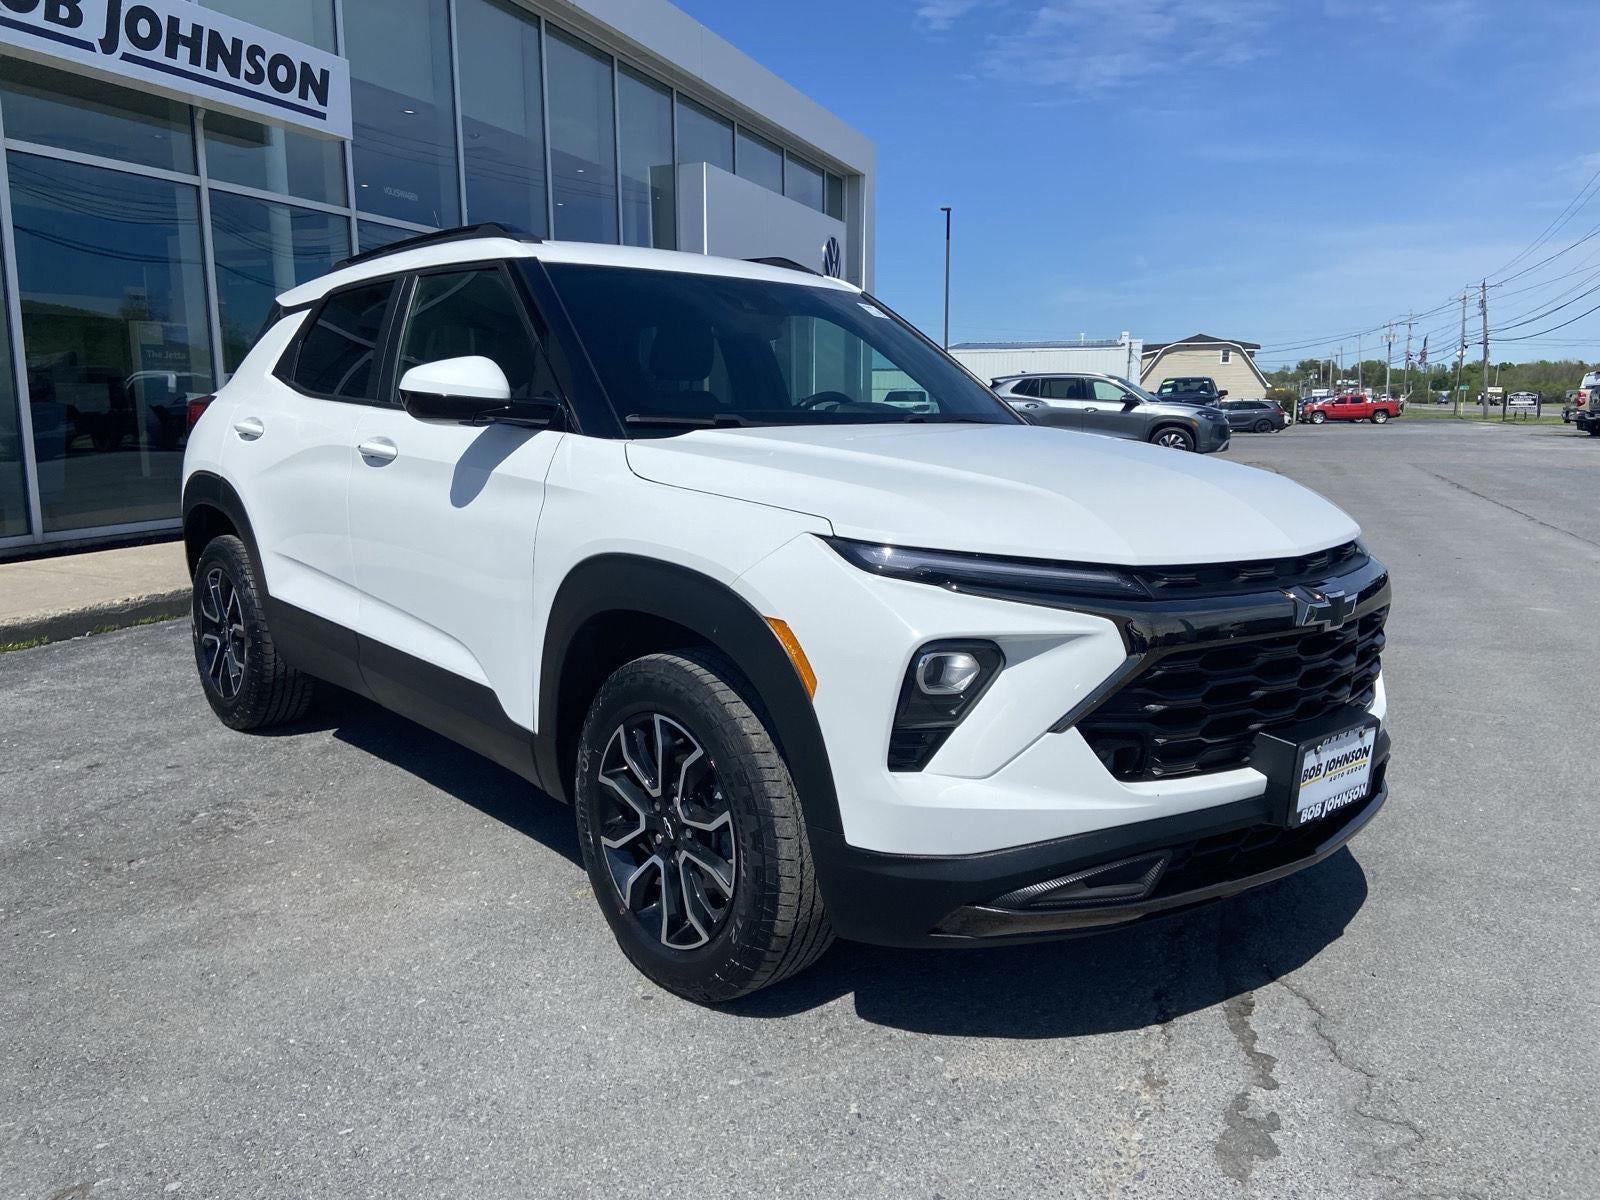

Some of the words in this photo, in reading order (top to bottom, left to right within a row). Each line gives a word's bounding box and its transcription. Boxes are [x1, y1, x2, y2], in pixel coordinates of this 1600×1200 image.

[98, 0, 330, 107] JOHNSON
[1301, 763, 1323, 783] BOB
[1323, 745, 1371, 778] JOHNSON
[1329, 772, 1345, 783] AUTO
[1346, 764, 1367, 776] GROUP
[1300, 803, 1322, 824] BOB
[1322, 783, 1368, 818] JOHNSON
